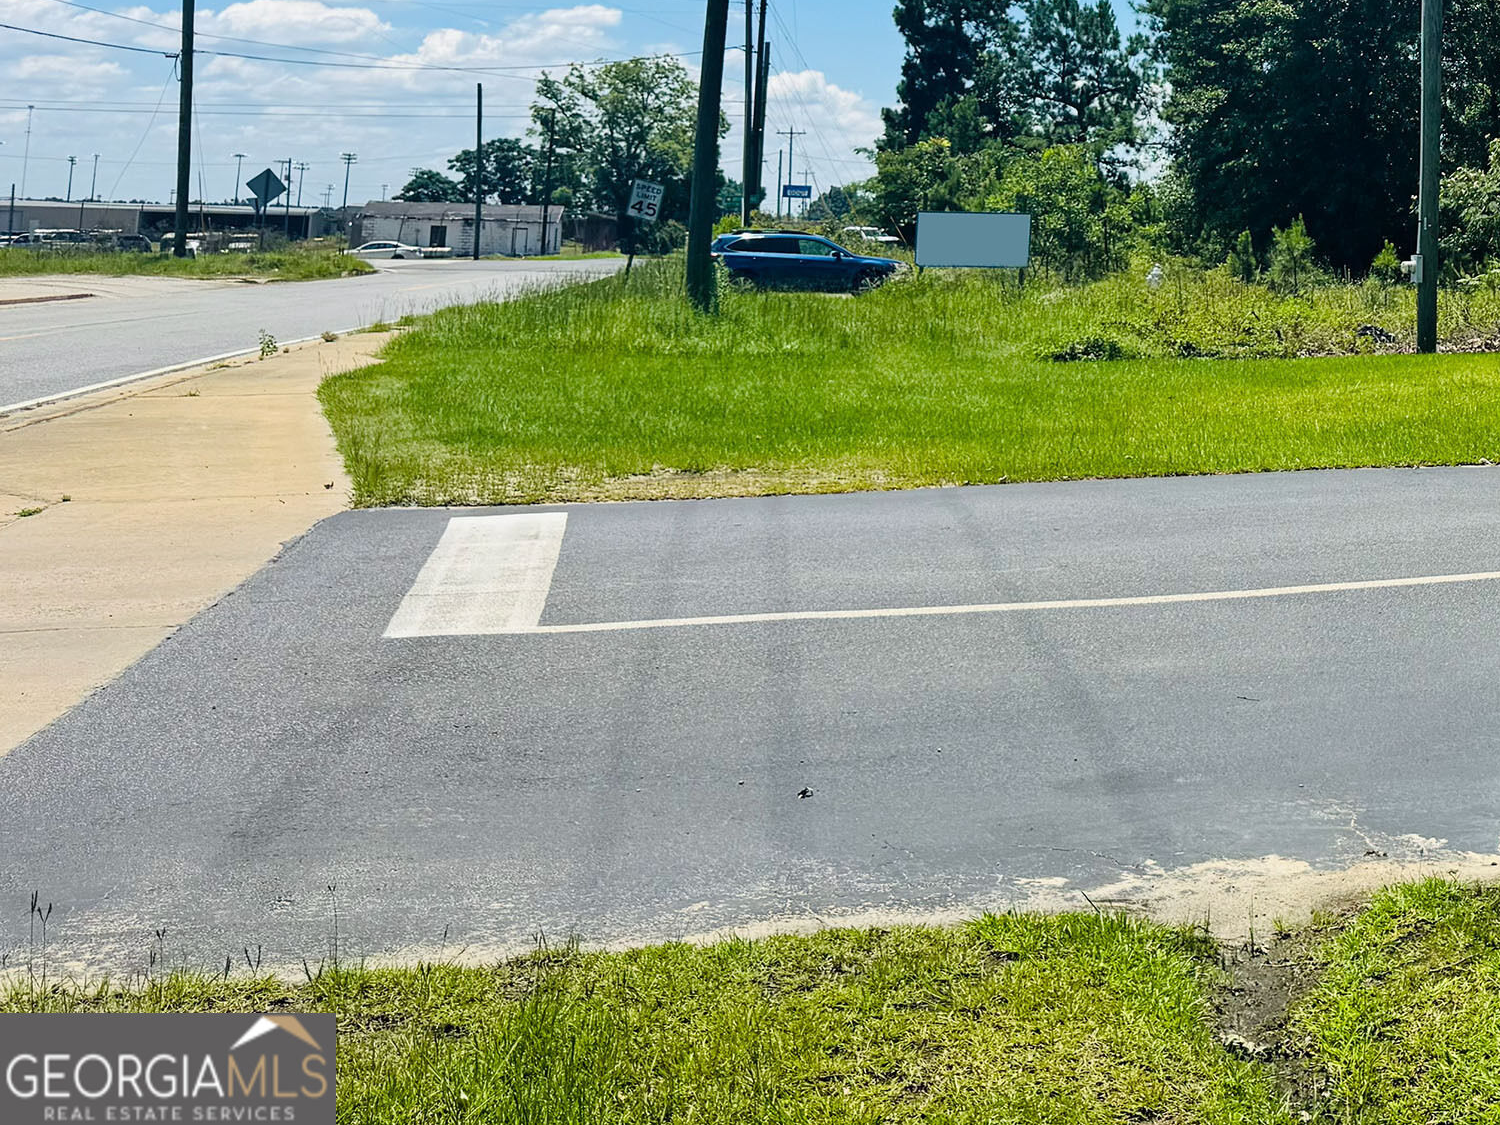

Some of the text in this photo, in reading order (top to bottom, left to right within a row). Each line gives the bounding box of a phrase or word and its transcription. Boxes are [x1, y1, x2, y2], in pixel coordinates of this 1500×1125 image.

[636, 183, 662, 195] SPEED
[636, 191, 657, 202] LIMIT
[631, 200, 657, 217] 45
